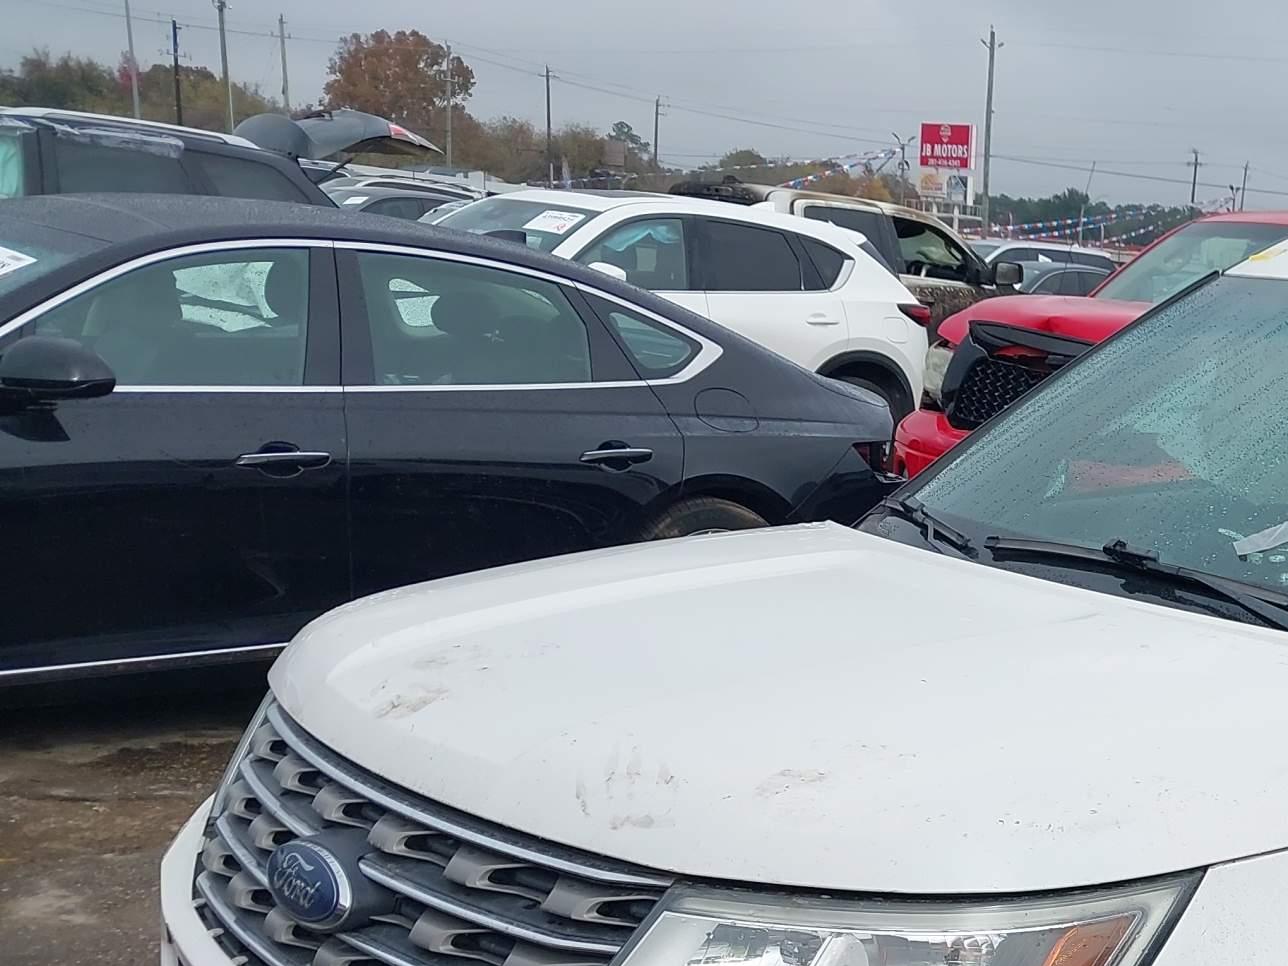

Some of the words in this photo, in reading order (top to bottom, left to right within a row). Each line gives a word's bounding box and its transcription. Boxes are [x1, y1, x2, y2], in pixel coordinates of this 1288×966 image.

[922, 143, 932, 156] JB
[934, 143, 968, 158] MOTORS
[273, 852, 323, 910] Ford
